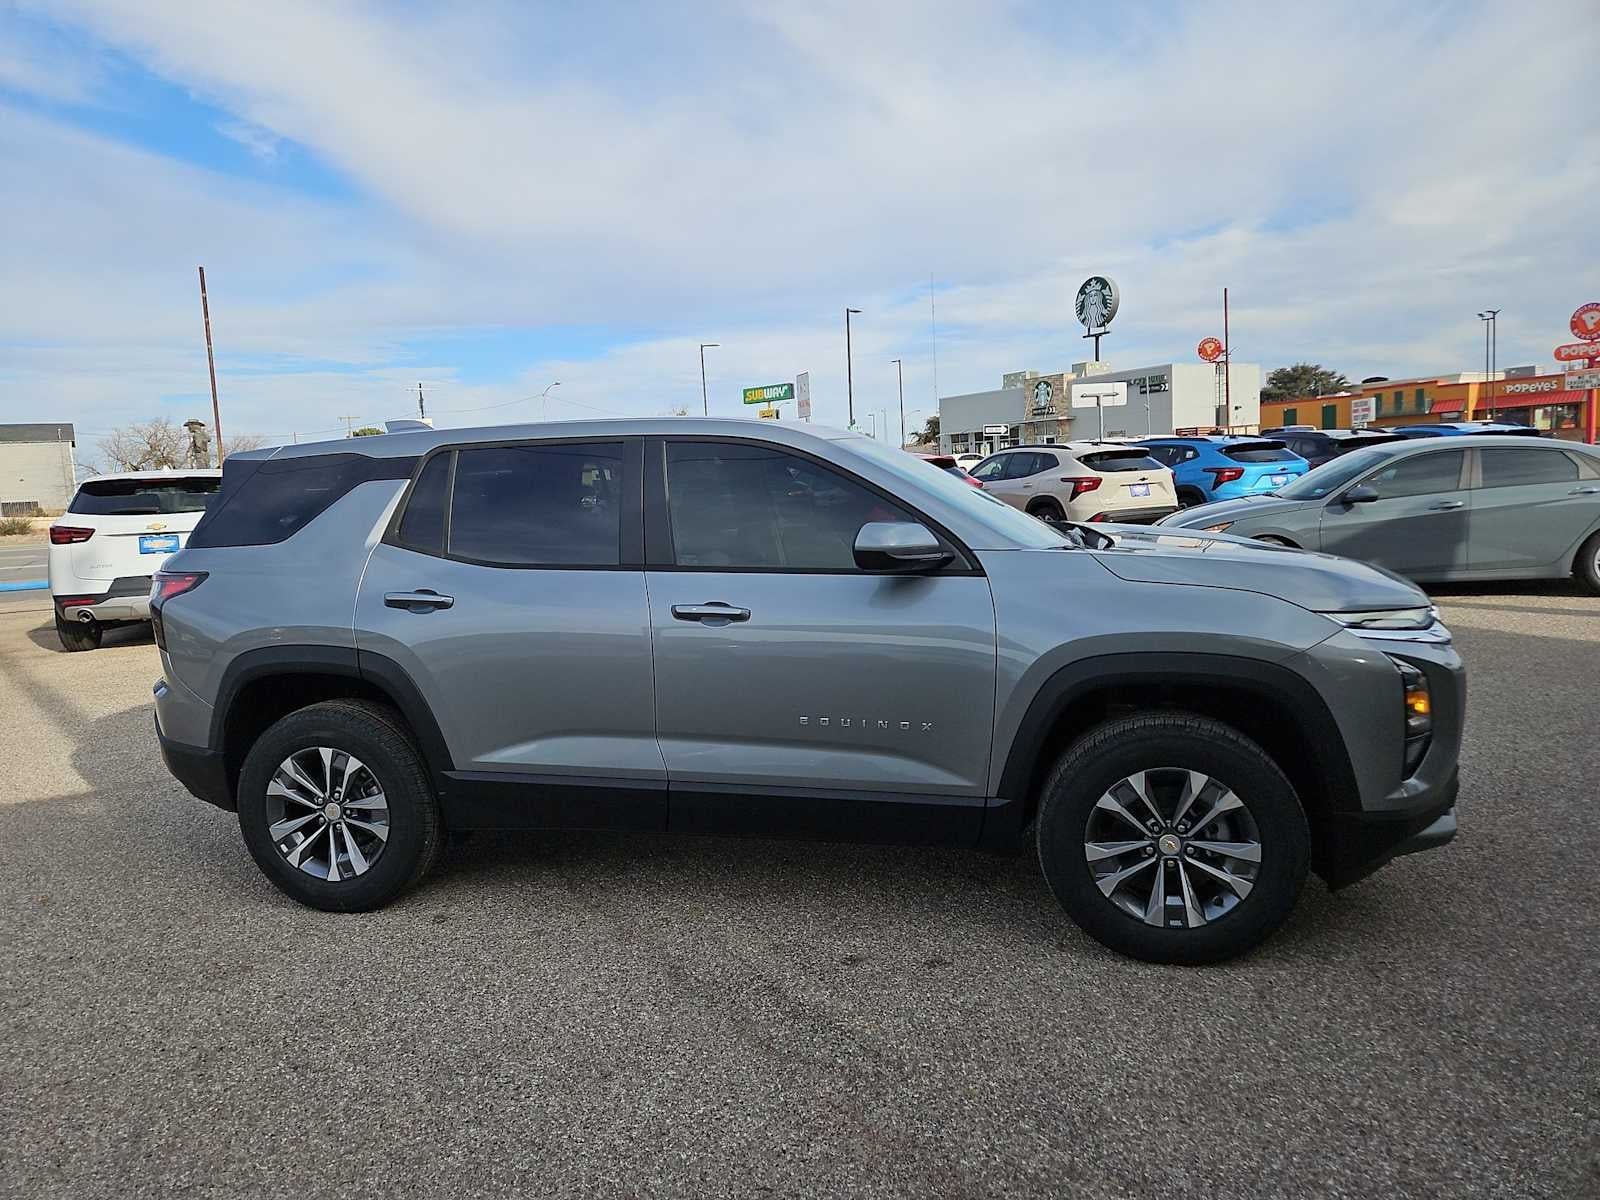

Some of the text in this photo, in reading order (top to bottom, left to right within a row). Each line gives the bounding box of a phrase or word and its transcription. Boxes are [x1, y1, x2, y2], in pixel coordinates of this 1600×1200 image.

[1203, 342, 1216, 356] P
[745, 385, 788, 401] SUBWAY
[799, 716, 932, 731] EQUINOX
